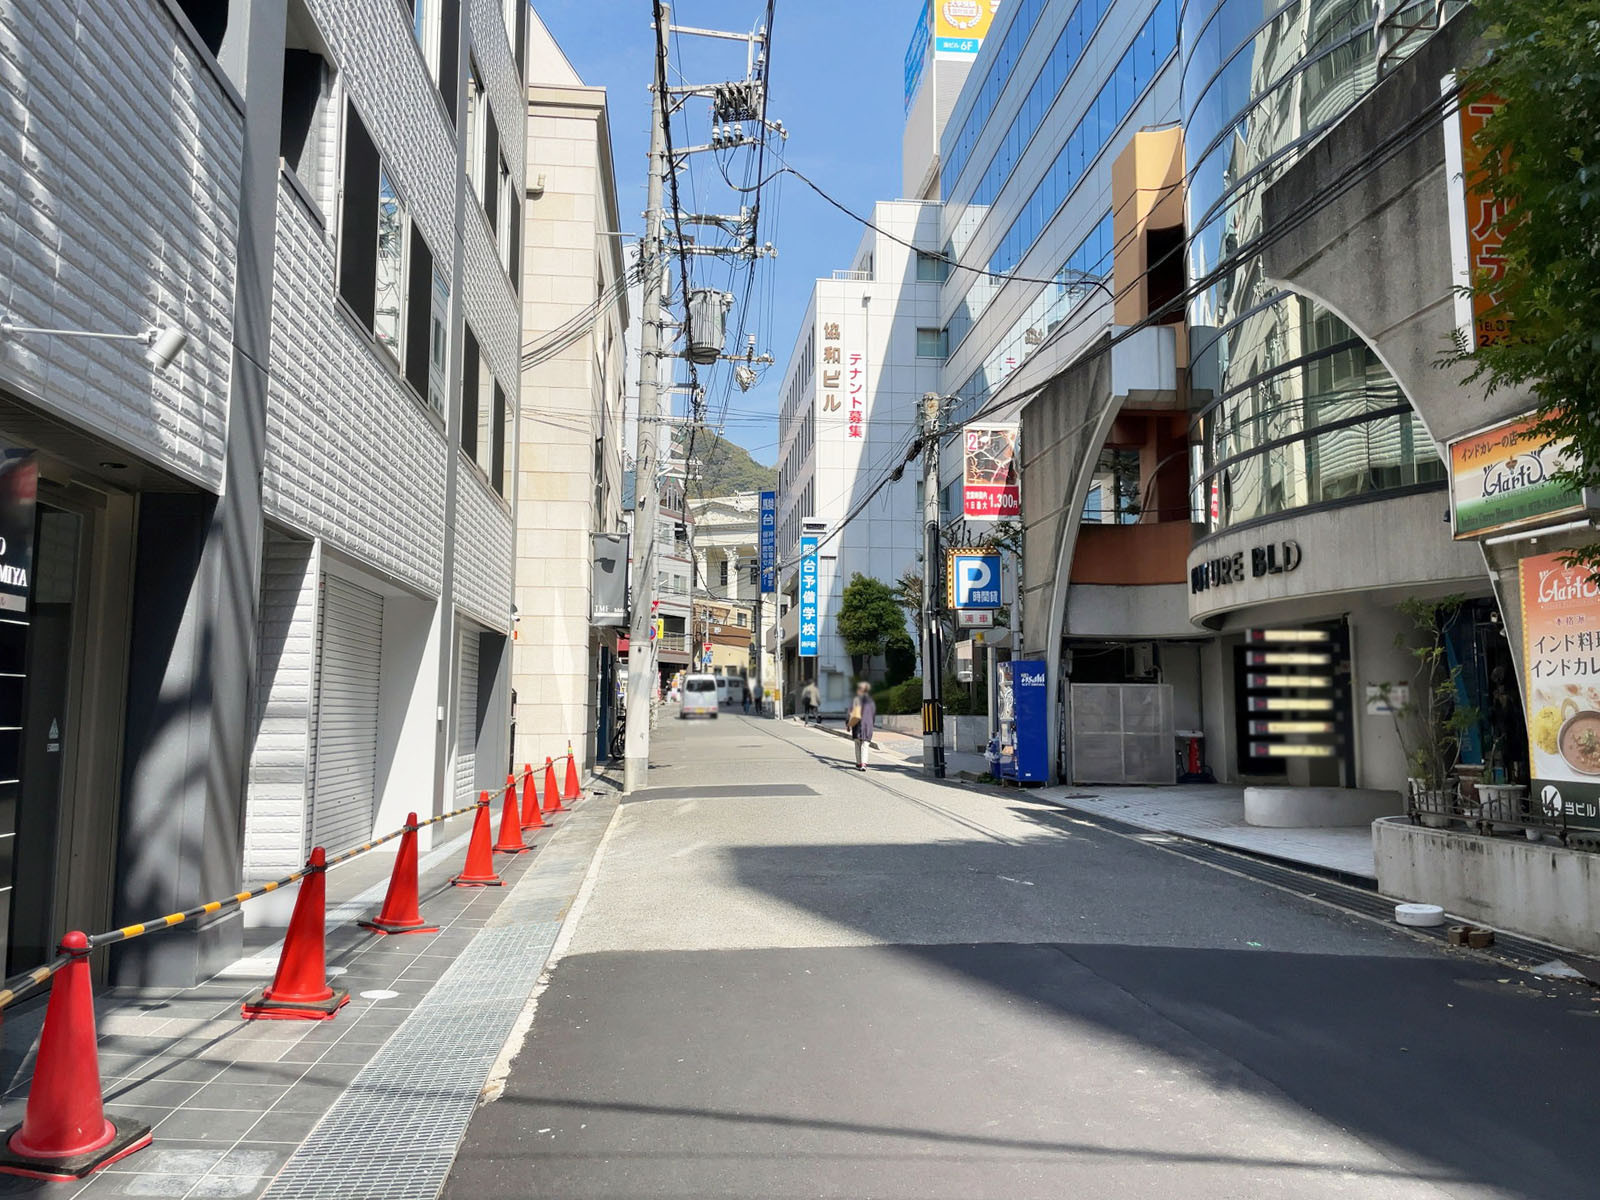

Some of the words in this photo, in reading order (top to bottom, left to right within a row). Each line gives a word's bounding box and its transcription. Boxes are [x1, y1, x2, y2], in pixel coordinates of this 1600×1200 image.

[823, 322, 841, 412] 協和ビル
[848, 353, 863, 438] テナント募集
[1484, 459, 1547, 497] Aarti
[958, 559, 991, 604] P
[1191, 551, 1245, 594] FUTURE
[1251, 540, 1302, 578] BLD
[802, 544, 816, 636] 駿台予備学校
[972, 590, 999, 603] 時間貸
[1021, 673, 1045, 683] Asahi
[1564, 801, 1596, 818] 当ビル
